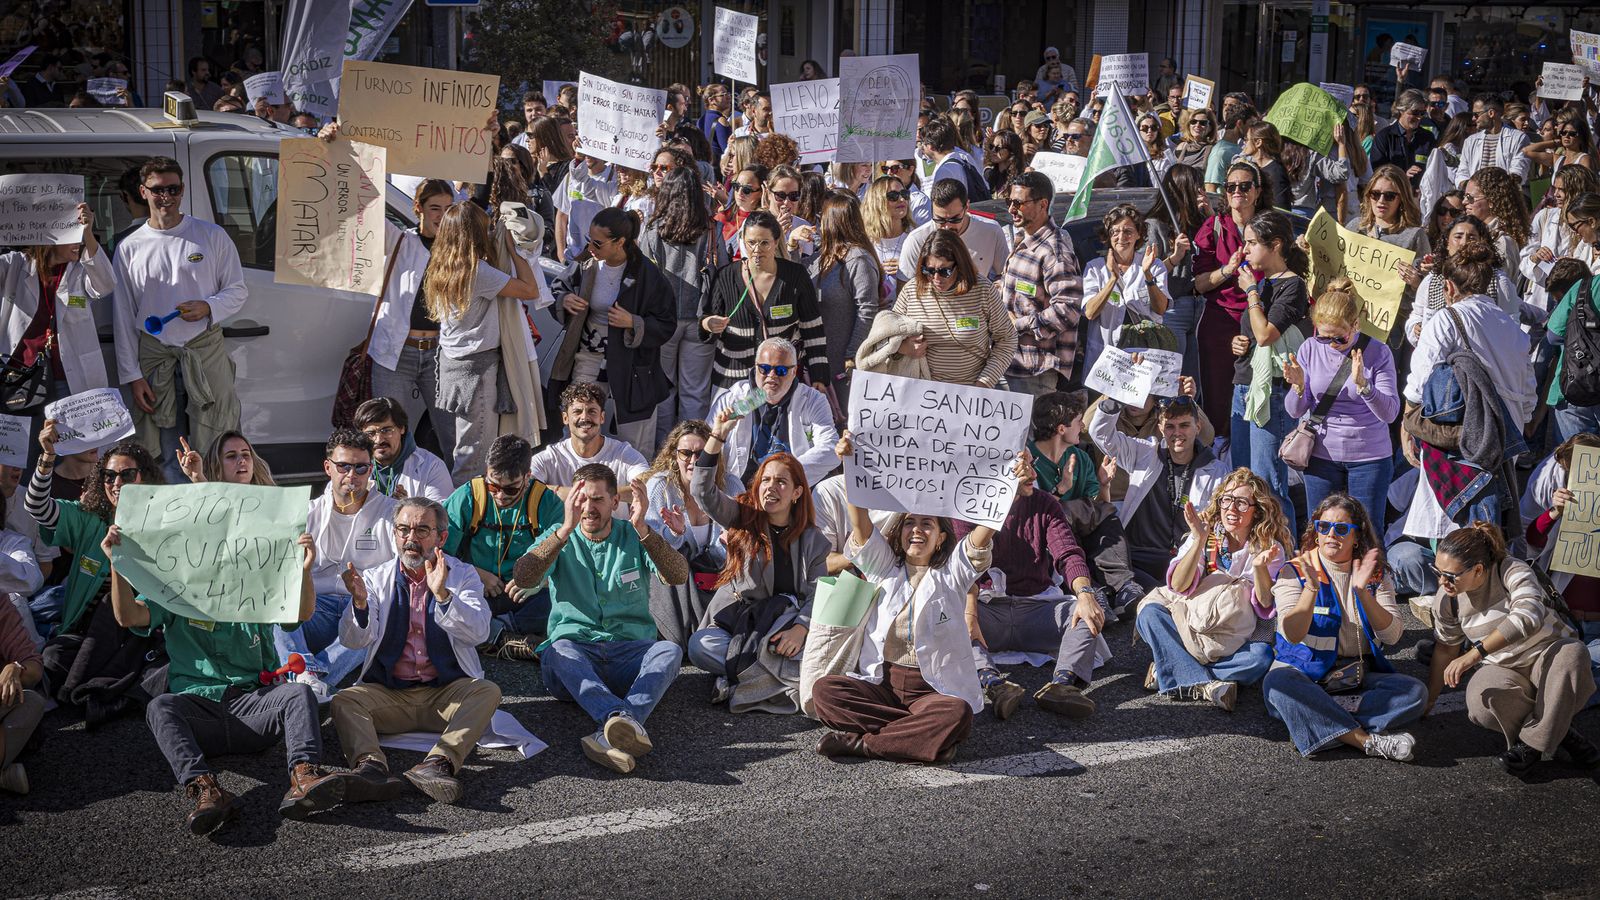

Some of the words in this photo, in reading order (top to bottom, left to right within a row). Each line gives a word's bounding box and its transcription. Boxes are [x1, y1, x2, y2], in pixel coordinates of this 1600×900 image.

[349, 69, 413, 94] TURNOS
[583, 77, 593, 88] SIN
[622, 89, 633, 100] SIN
[637, 94, 662, 104] PARAR
[593, 96, 611, 108] ERROR
[613, 101, 631, 114] PUEDE
[634, 108, 656, 118] MATAR
[782, 84, 829, 112] LLEVO
[340, 121, 403, 141] CONTRATOS
[415, 121, 487, 155] FINITOS
[619, 127, 648, 142] AGOTADO
[611, 145, 620, 155] EN
[625, 147, 651, 160] RIESGO
[337, 163, 351, 178] UN
[41, 183, 53, 193] NO
[337, 181, 349, 214] ERROR
[290, 161, 329, 257] MATAR
[1338, 236, 1401, 272] QUERÍA
[1339, 264, 1382, 290] MÉDICO
[863, 379, 896, 402] LA
[920, 389, 1023, 421] SANIDAD
[859, 407, 947, 433] PÚBLICA
[964, 423, 1000, 441] NO
[854, 432, 919, 448] CUIDA
[932, 438, 957, 455] DE
[963, 444, 1018, 463] TODO
[966, 462, 978, 475] A
[855, 470, 945, 500] MÉDICOS!
[961, 481, 1007, 498] STOP
[155, 533, 299, 573] GUARDIA
